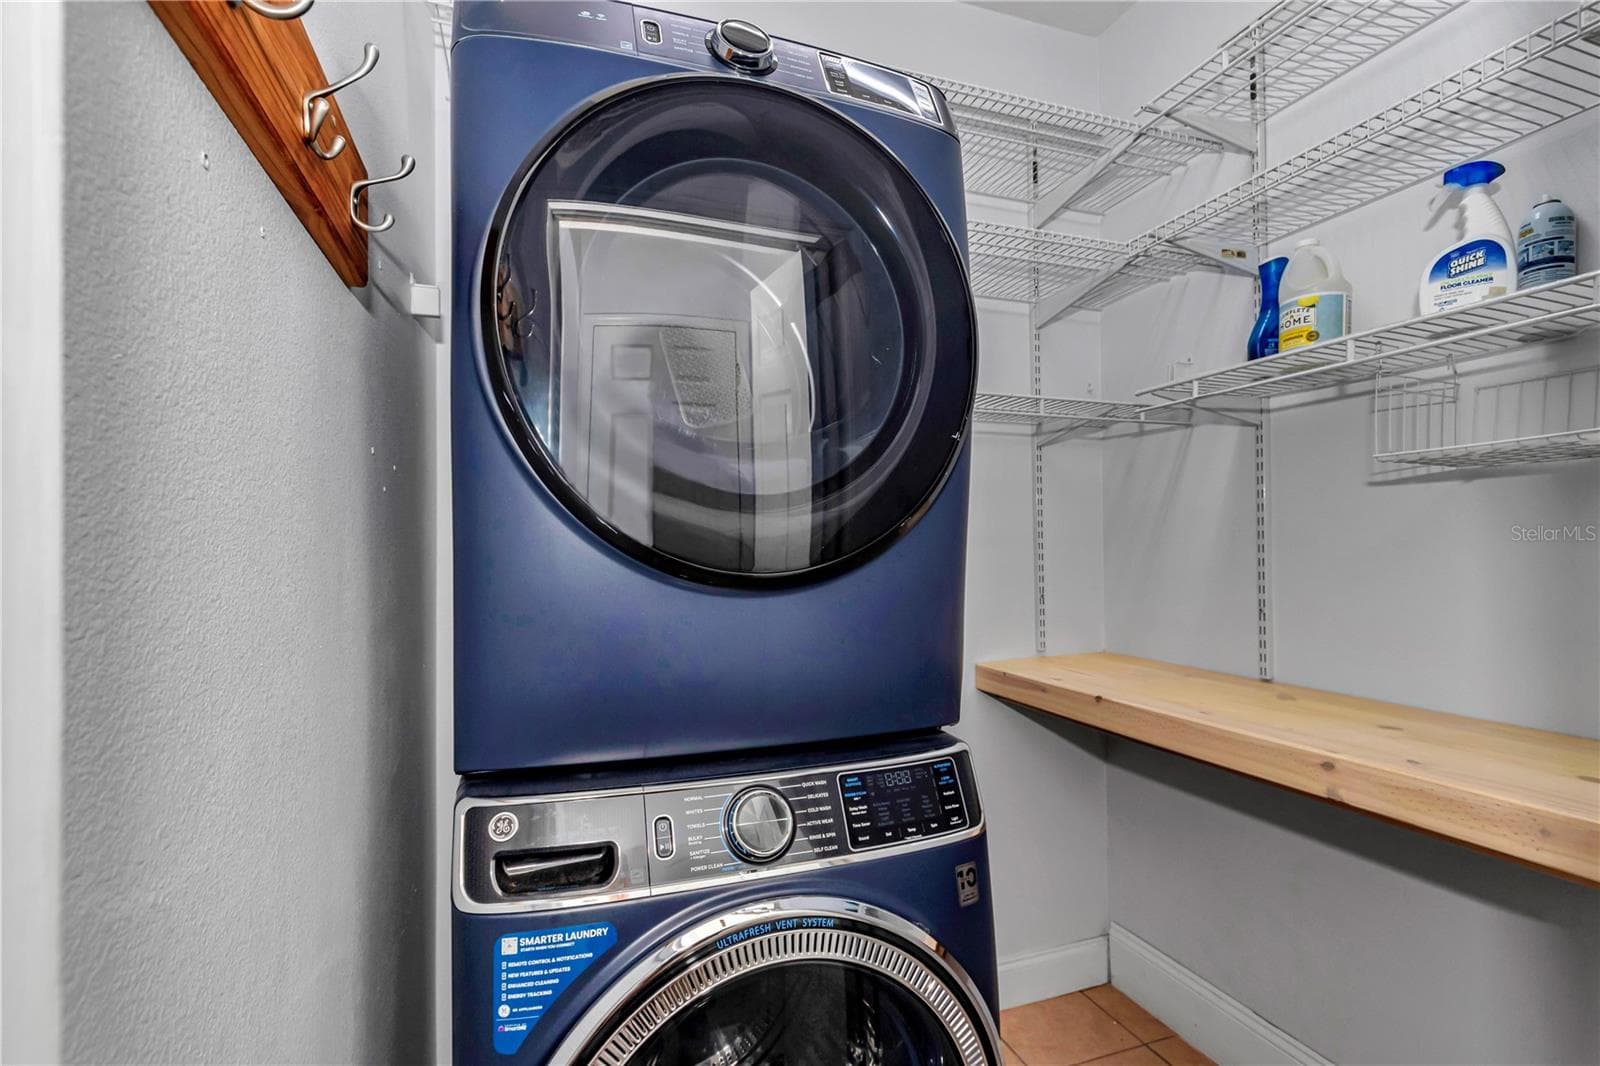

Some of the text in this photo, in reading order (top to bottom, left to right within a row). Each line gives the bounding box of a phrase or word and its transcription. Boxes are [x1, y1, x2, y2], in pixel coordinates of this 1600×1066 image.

[1450, 250, 1484, 267] QUICK
[1450, 258, 1485, 275] SHINE
[1440, 282, 1461, 290] FLOOR
[1463, 277, 1494, 286] CLEANER
[520, 927, 609, 947] SMARTER LAUNDRY
[716, 917, 834, 949] ULTRAFRESH VENT SYSTEM
[528, 958, 551, 966] CONTROL
[556, 952, 593, 962] NOTIFICATIONS
[520, 970, 543, 978] FEATURES
[549, 966, 571, 974] UPDATES
[508, 979, 559, 989] ENHANCED CLEANING
